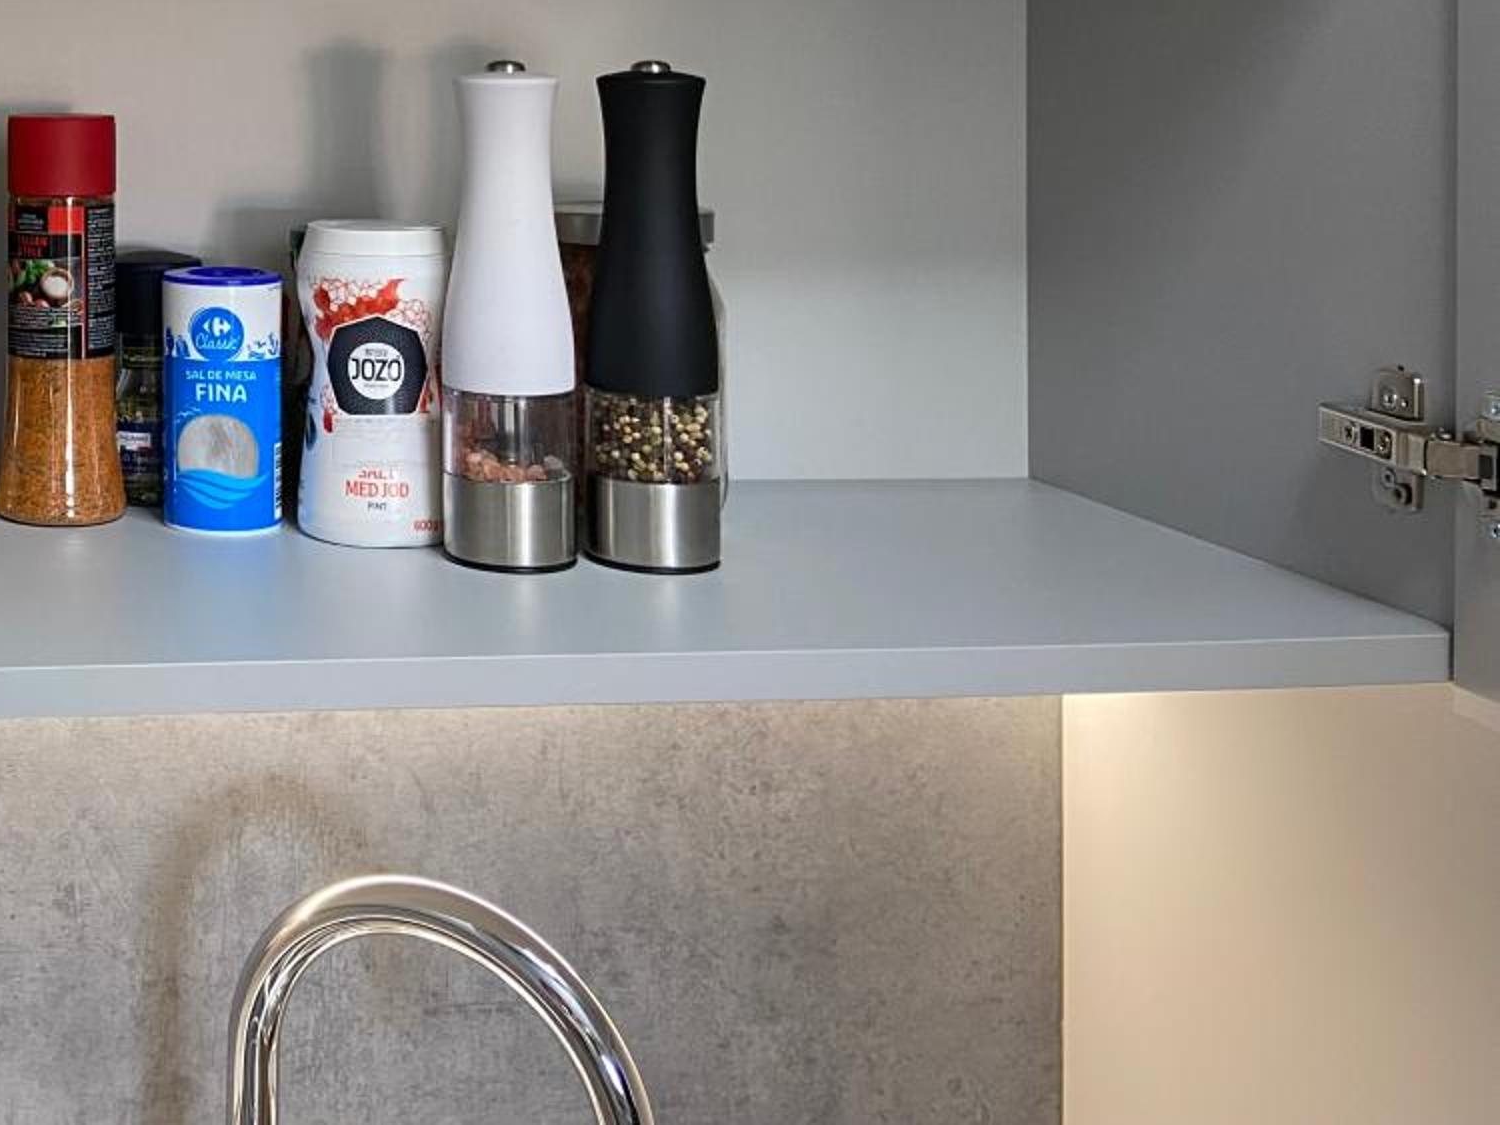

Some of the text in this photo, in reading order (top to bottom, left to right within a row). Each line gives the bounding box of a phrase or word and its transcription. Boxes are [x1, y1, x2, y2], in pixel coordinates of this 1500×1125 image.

[185, 370, 257, 380] SAL DE MESA
[351, 358, 402, 382] JOZO
[195, 383, 248, 403] FINA
[346, 480, 409, 498] MED JOD
